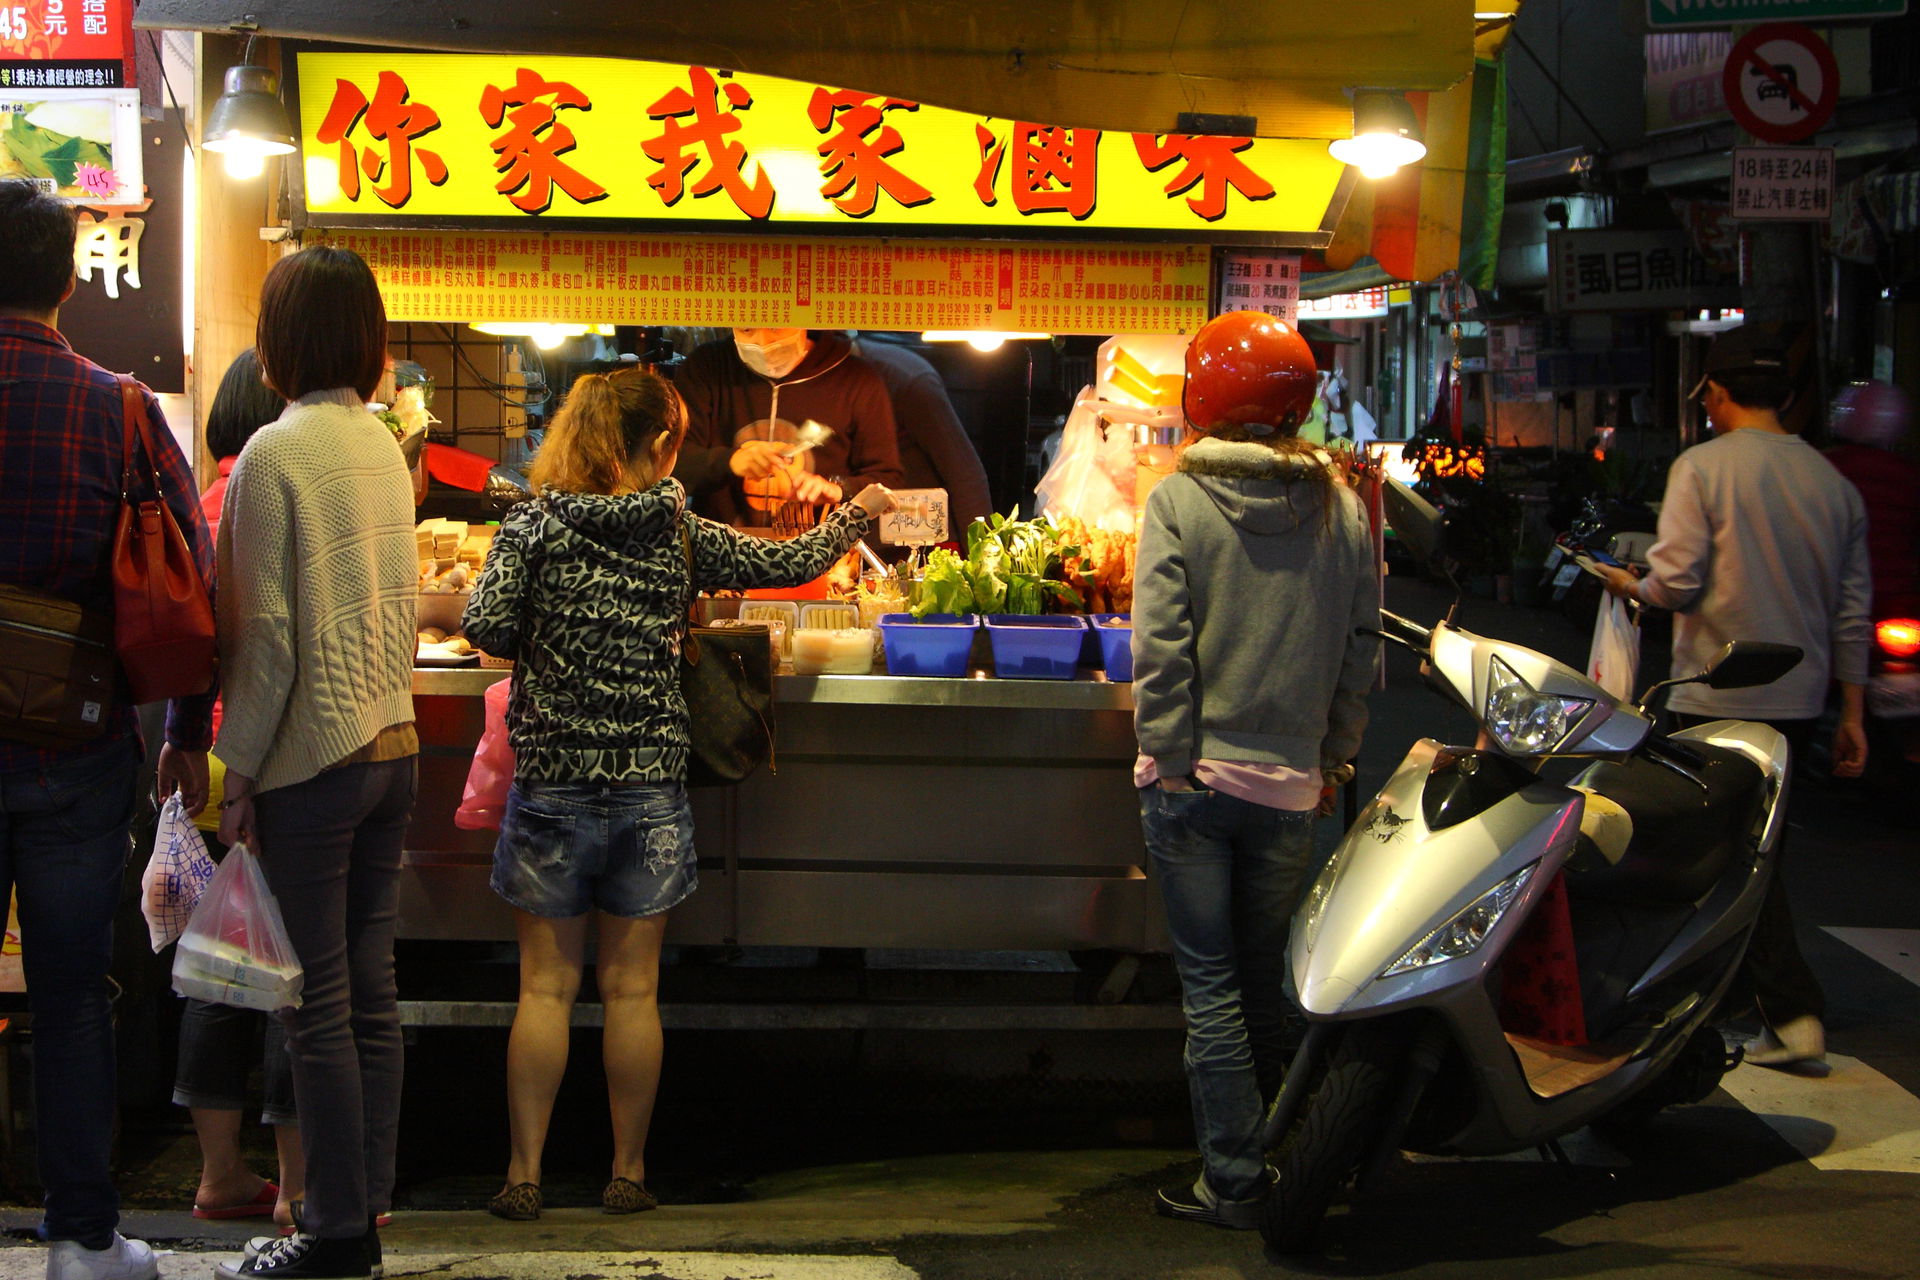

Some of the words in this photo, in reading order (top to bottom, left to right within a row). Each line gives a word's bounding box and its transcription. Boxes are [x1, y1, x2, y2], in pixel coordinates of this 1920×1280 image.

[315, 65, 1277, 222] 你家我家滷味
[498, 238, 507, 288] 米血
[562, 239, 572, 289] 豆包
[629, 240, 638, 291] 豆皮
[705, 241, 715, 292] 苦瓜丸
[760, 243, 770, 293] 魚餃
[815, 244, 825, 294] 豆芽菜
[849, 245, 859, 295] 空心菜
[871, 245, 881, 295] 小黃瓜
[882, 246, 892, 296] 四季豆
[927, 247, 937, 297] 木耳
